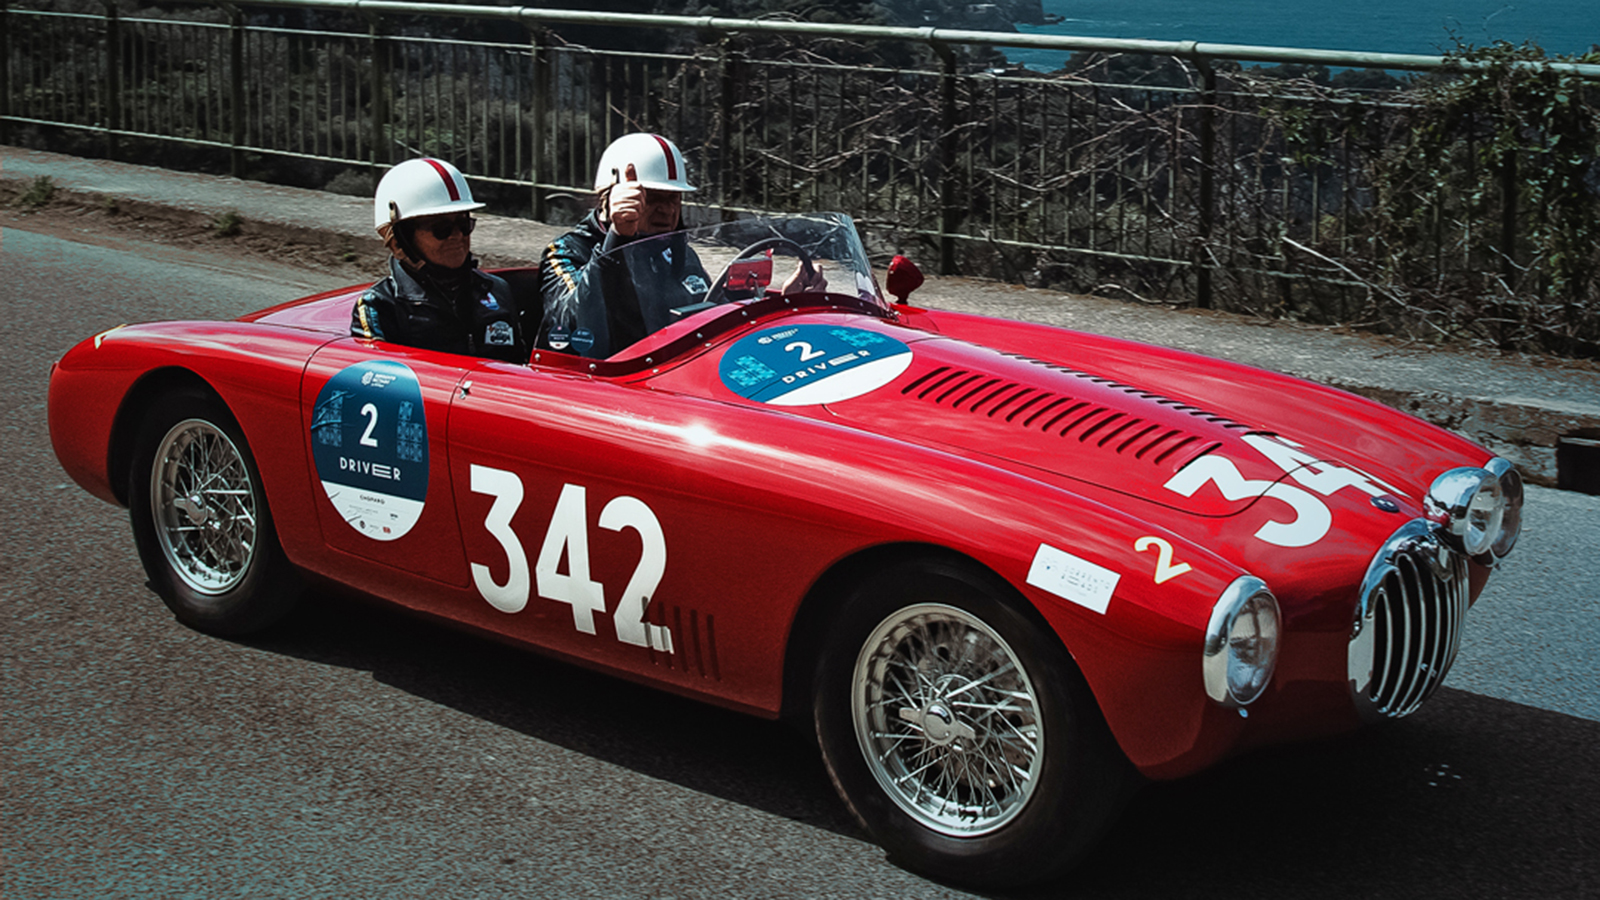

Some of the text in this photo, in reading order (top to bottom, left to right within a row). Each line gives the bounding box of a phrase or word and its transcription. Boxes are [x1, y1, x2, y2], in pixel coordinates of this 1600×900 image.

[781, 350, 871, 384] DRIVER
[784, 341, 826, 362] 2
[360, 402, 379, 448] 2
[339, 456, 401, 481] DRIVER
[469, 463, 675, 655] 342
[1134, 536, 1193, 585] 2
